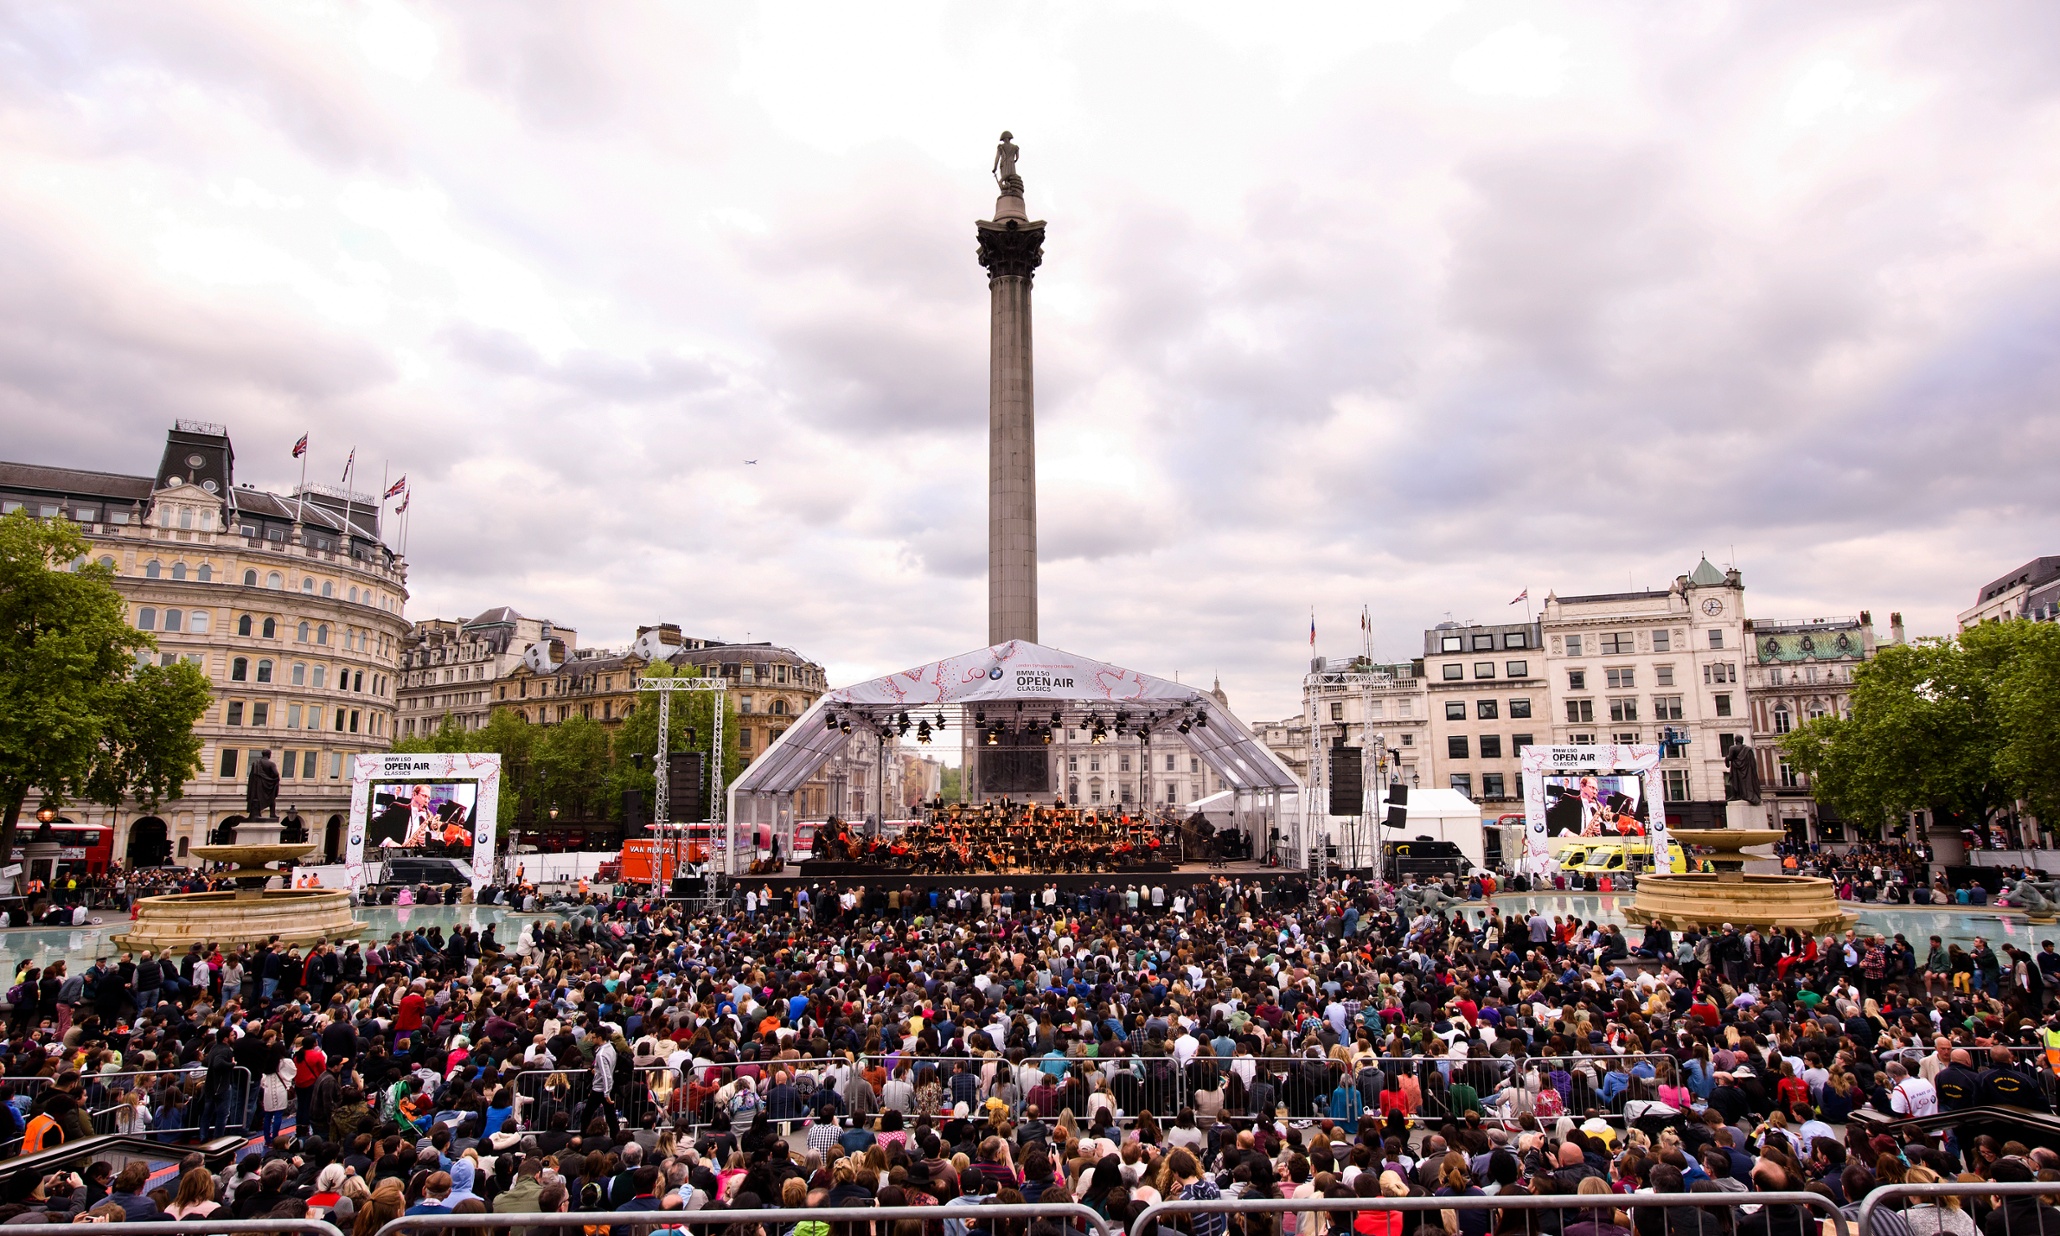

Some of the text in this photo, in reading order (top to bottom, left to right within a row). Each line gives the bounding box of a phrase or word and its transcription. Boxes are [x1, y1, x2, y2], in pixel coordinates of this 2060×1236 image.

[1016, 677, 1074, 688] OPEN AIR
[1552, 753, 1596, 761] OPEN AIR
[384, 763, 411, 771] OPEN
